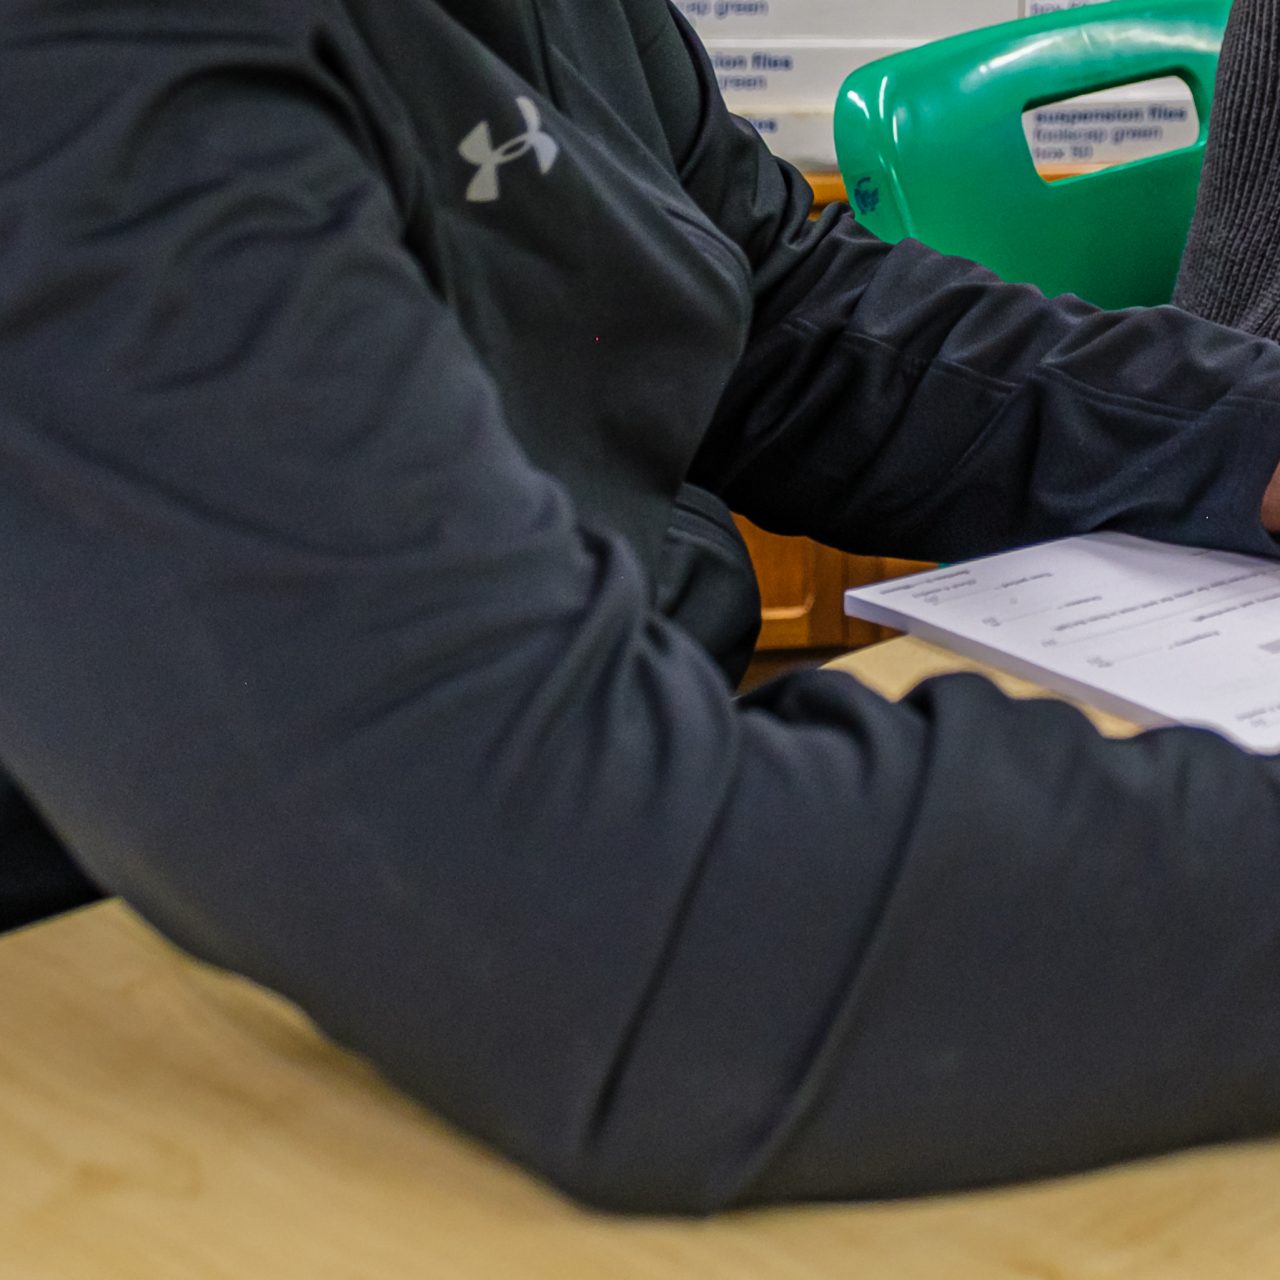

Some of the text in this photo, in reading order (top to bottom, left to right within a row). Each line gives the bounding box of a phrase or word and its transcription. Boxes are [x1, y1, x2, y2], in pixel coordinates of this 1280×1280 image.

[714, 0, 768, 19] green
[752, 52, 793, 70] files
[1036, 105, 1188, 124] suspension files
[1035, 127, 1163, 144] foolscap green
